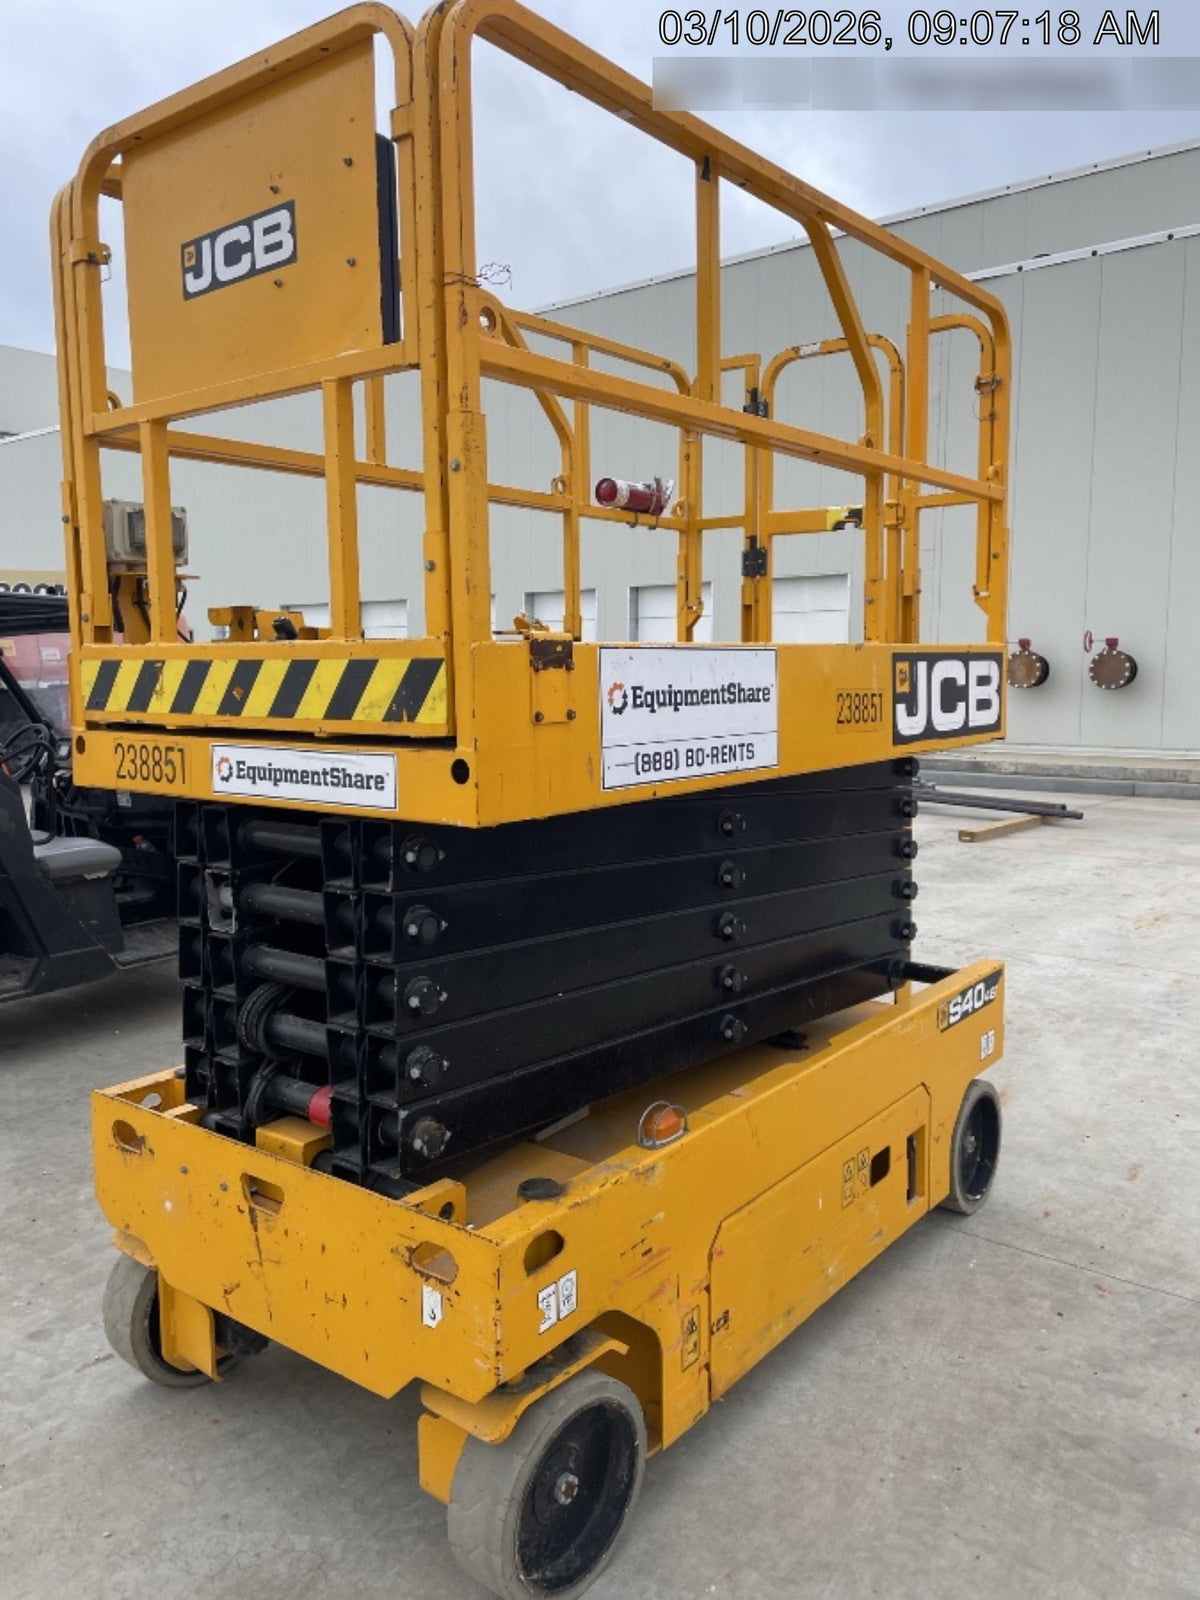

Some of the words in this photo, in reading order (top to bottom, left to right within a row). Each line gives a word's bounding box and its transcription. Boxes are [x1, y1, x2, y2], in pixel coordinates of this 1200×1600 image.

[185, 209, 294, 294] JCB
[631, 682, 771, 713] EquipmentShare
[836, 692, 883, 724] 238851
[896, 659, 1000, 736] JCB
[114, 742, 186, 785] 238851
[236, 760, 385, 791] EquipmentShare
[634, 748, 680, 775] (888)
